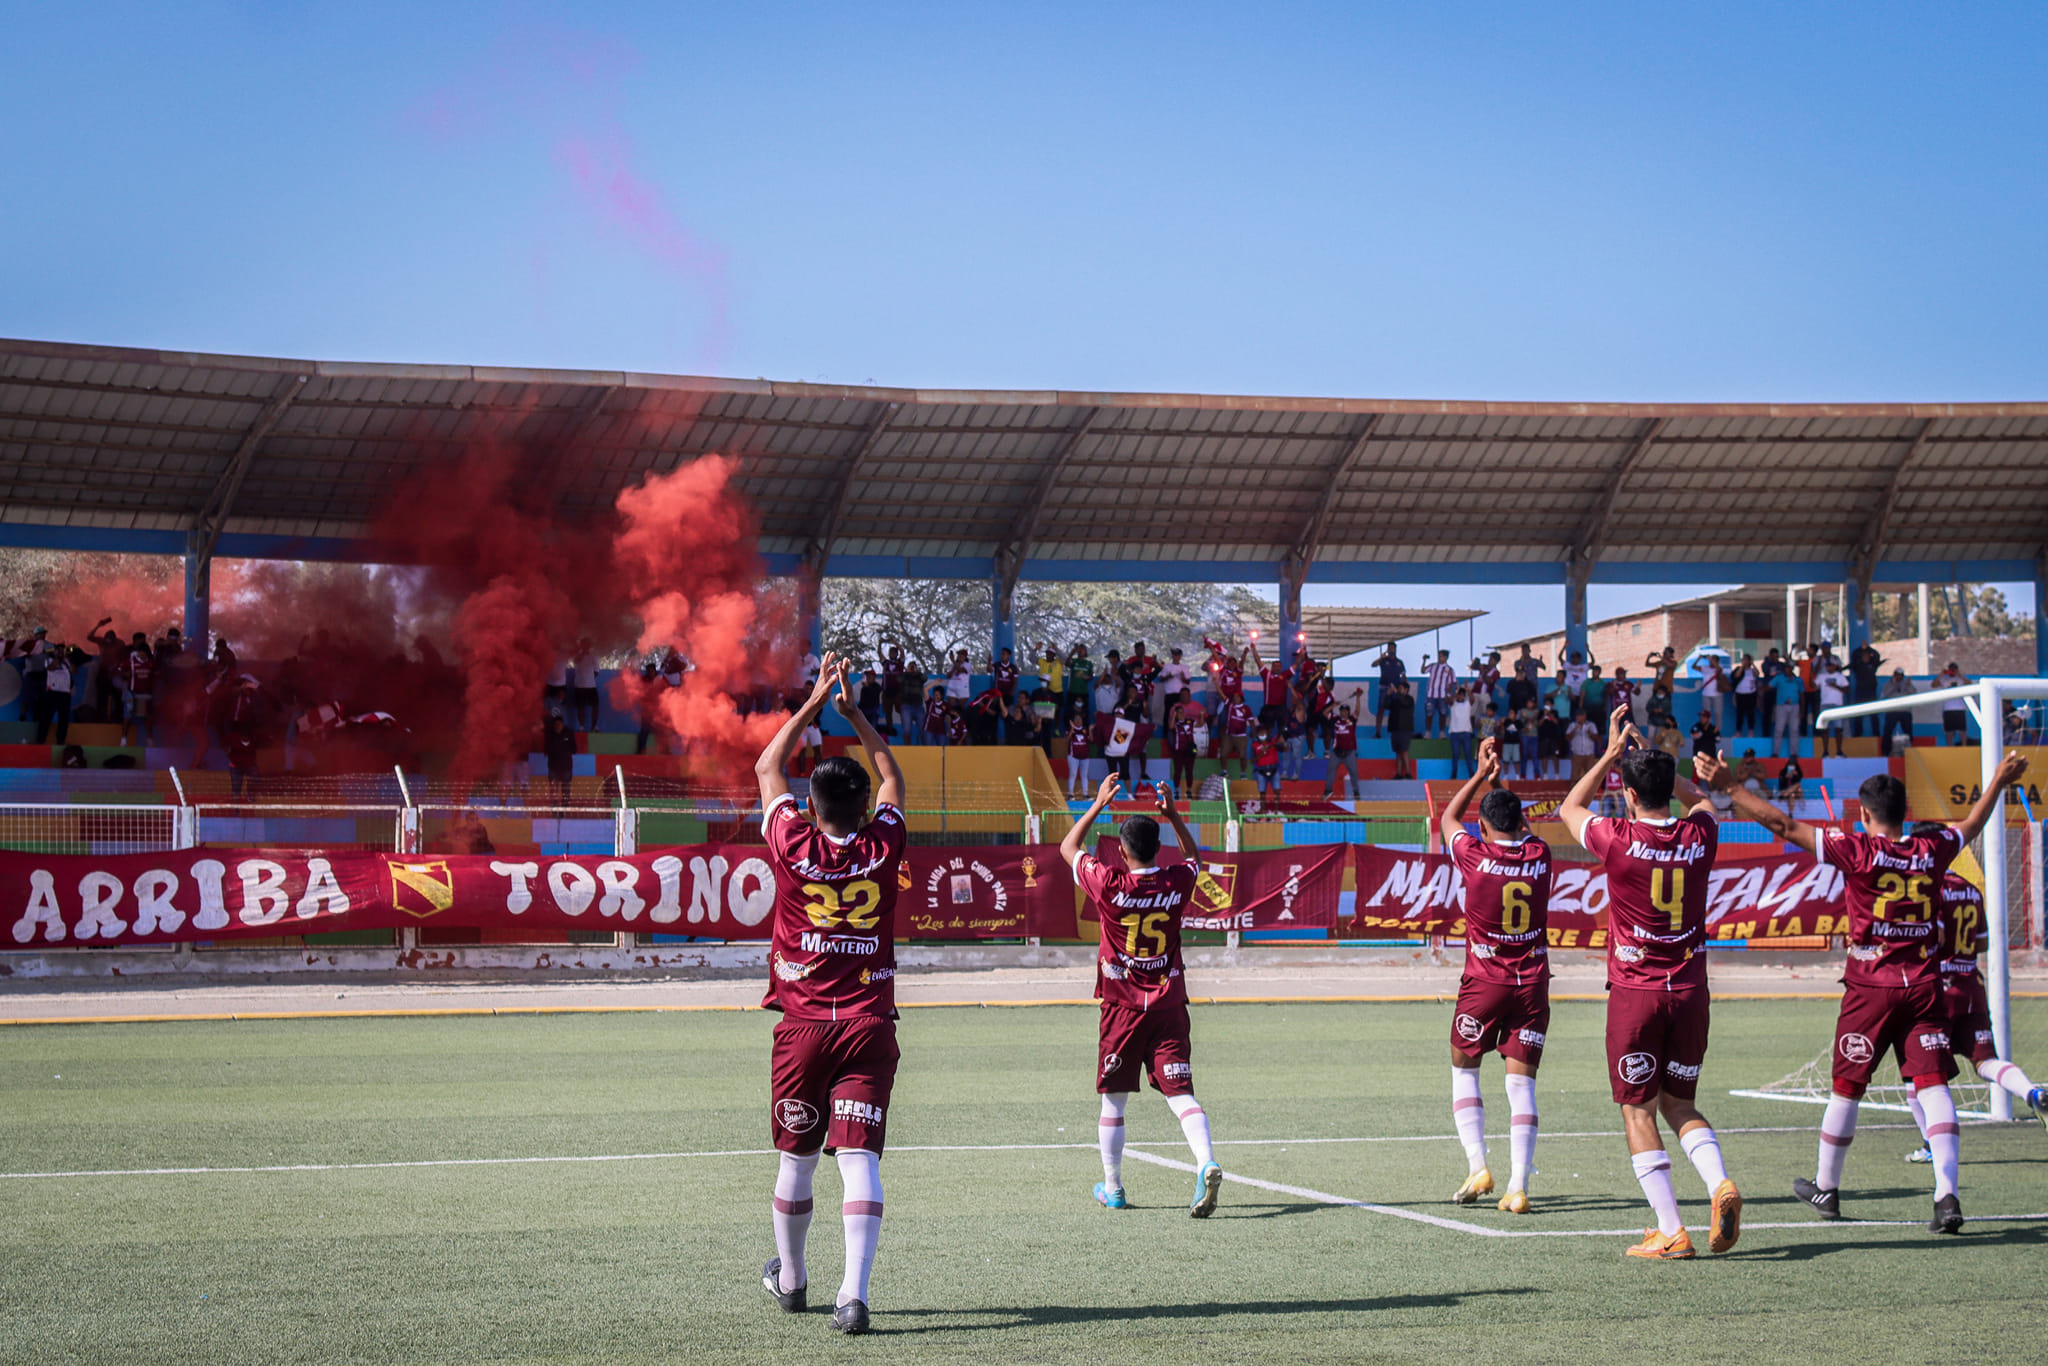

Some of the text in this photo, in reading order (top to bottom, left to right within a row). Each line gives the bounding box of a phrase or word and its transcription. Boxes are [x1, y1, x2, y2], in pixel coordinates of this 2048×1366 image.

[949, 857, 965, 871] DEL
[1625, 841, 1705, 866] New Life
[1476, 858, 1547, 880] New Life
[12, 855, 777, 944] ARRIBA TORINO
[1111, 890, 1182, 911] New Life
[1502, 881, 1532, 935] 6
[1651, 868, 1684, 931] 4
[1873, 873, 1934, 922] 25
[1120, 912, 1170, 958] 15
[1717, 920, 1757, 940] EN
[1767, 916, 1802, 937] LA
[1814, 914, 1849, 935] BA
[1872, 921, 1933, 937] MONTERO
[1953, 905, 1978, 955] 12
[801, 932, 879, 956] MONTERO
